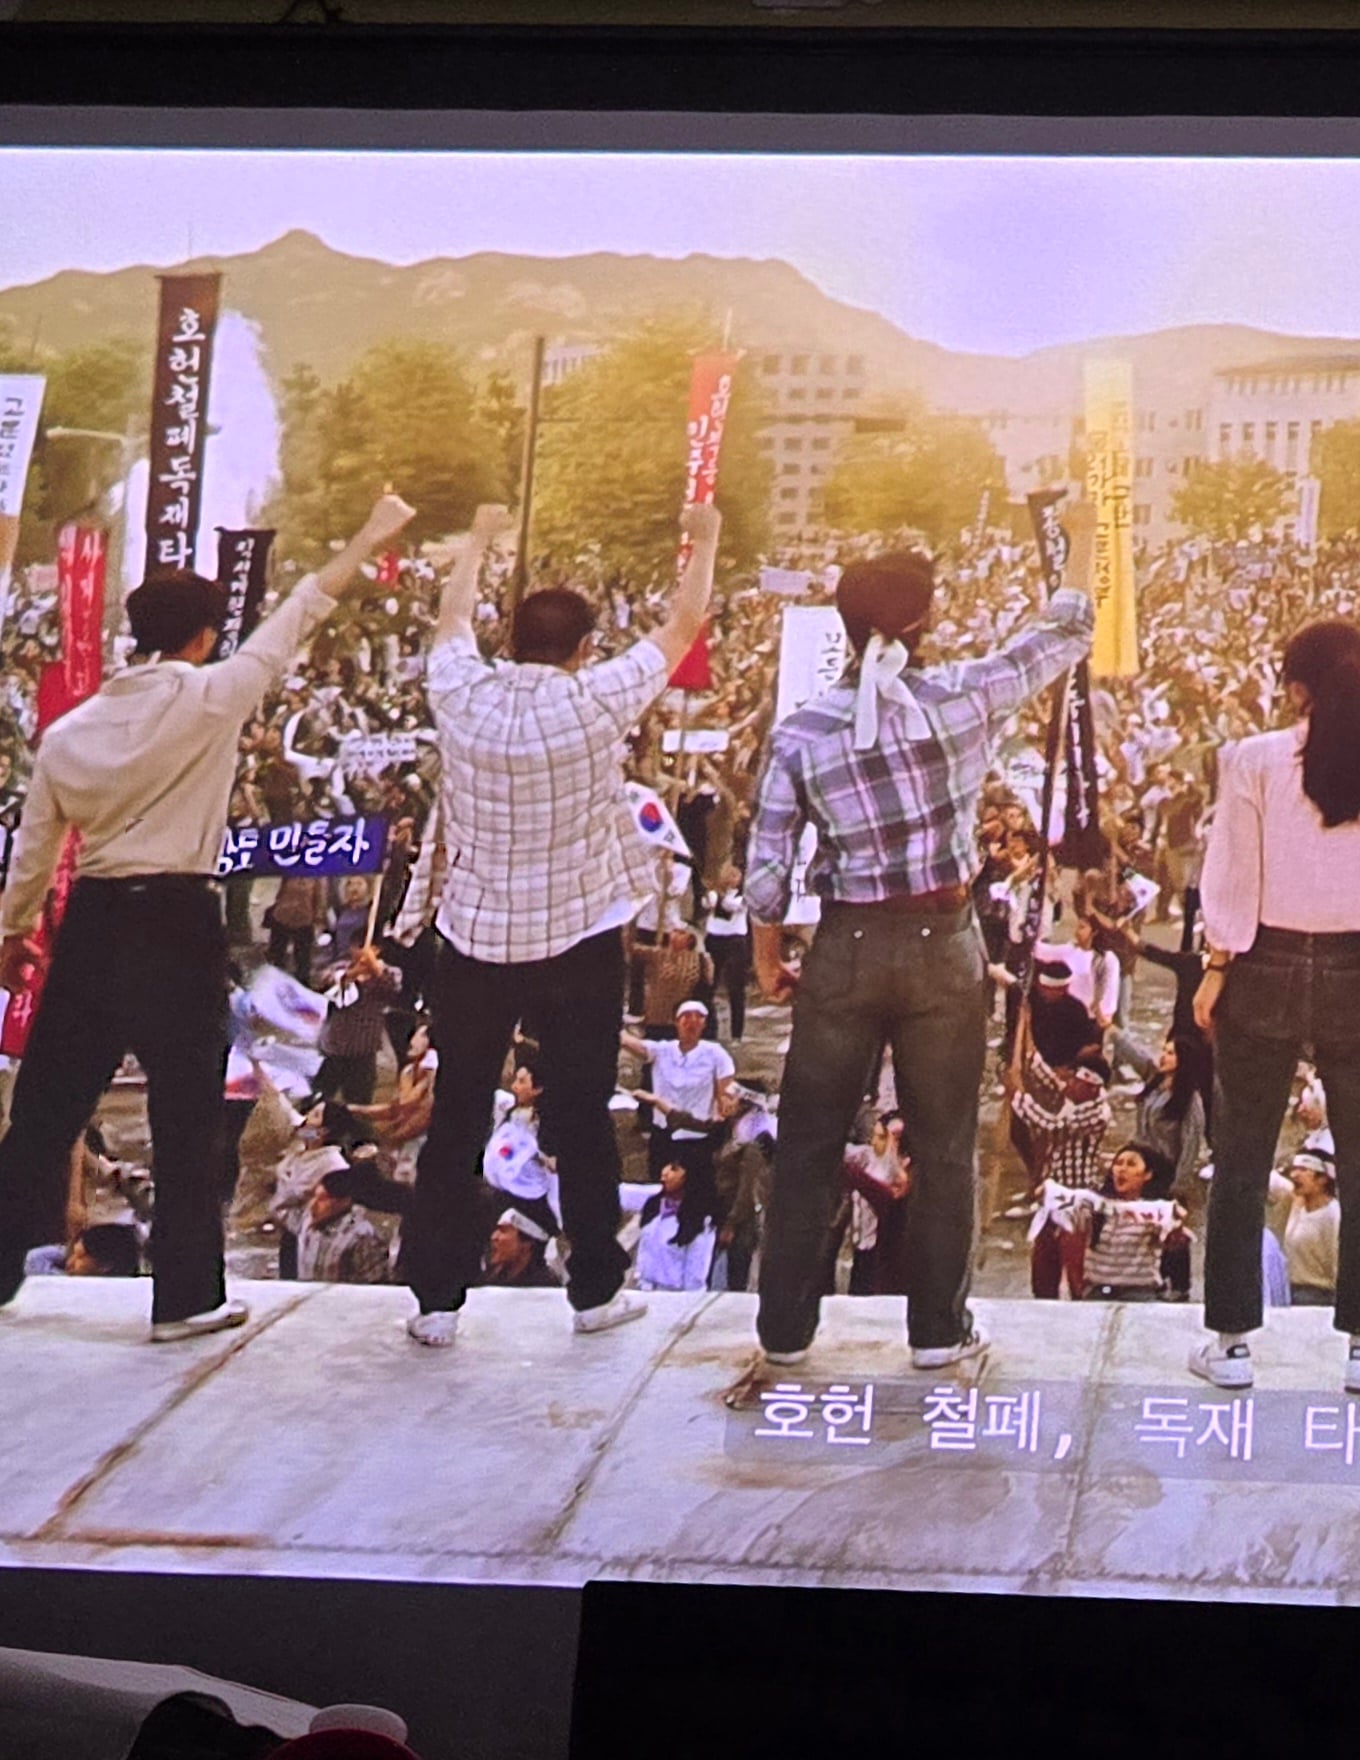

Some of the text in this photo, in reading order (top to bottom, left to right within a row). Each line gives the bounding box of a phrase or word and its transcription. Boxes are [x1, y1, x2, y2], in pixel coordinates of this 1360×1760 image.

[753, 1383, 875, 1446] 호헌
[922, 1387, 1072, 1460] 철폐,
[1133, 1397, 1255, 1462] 독재
